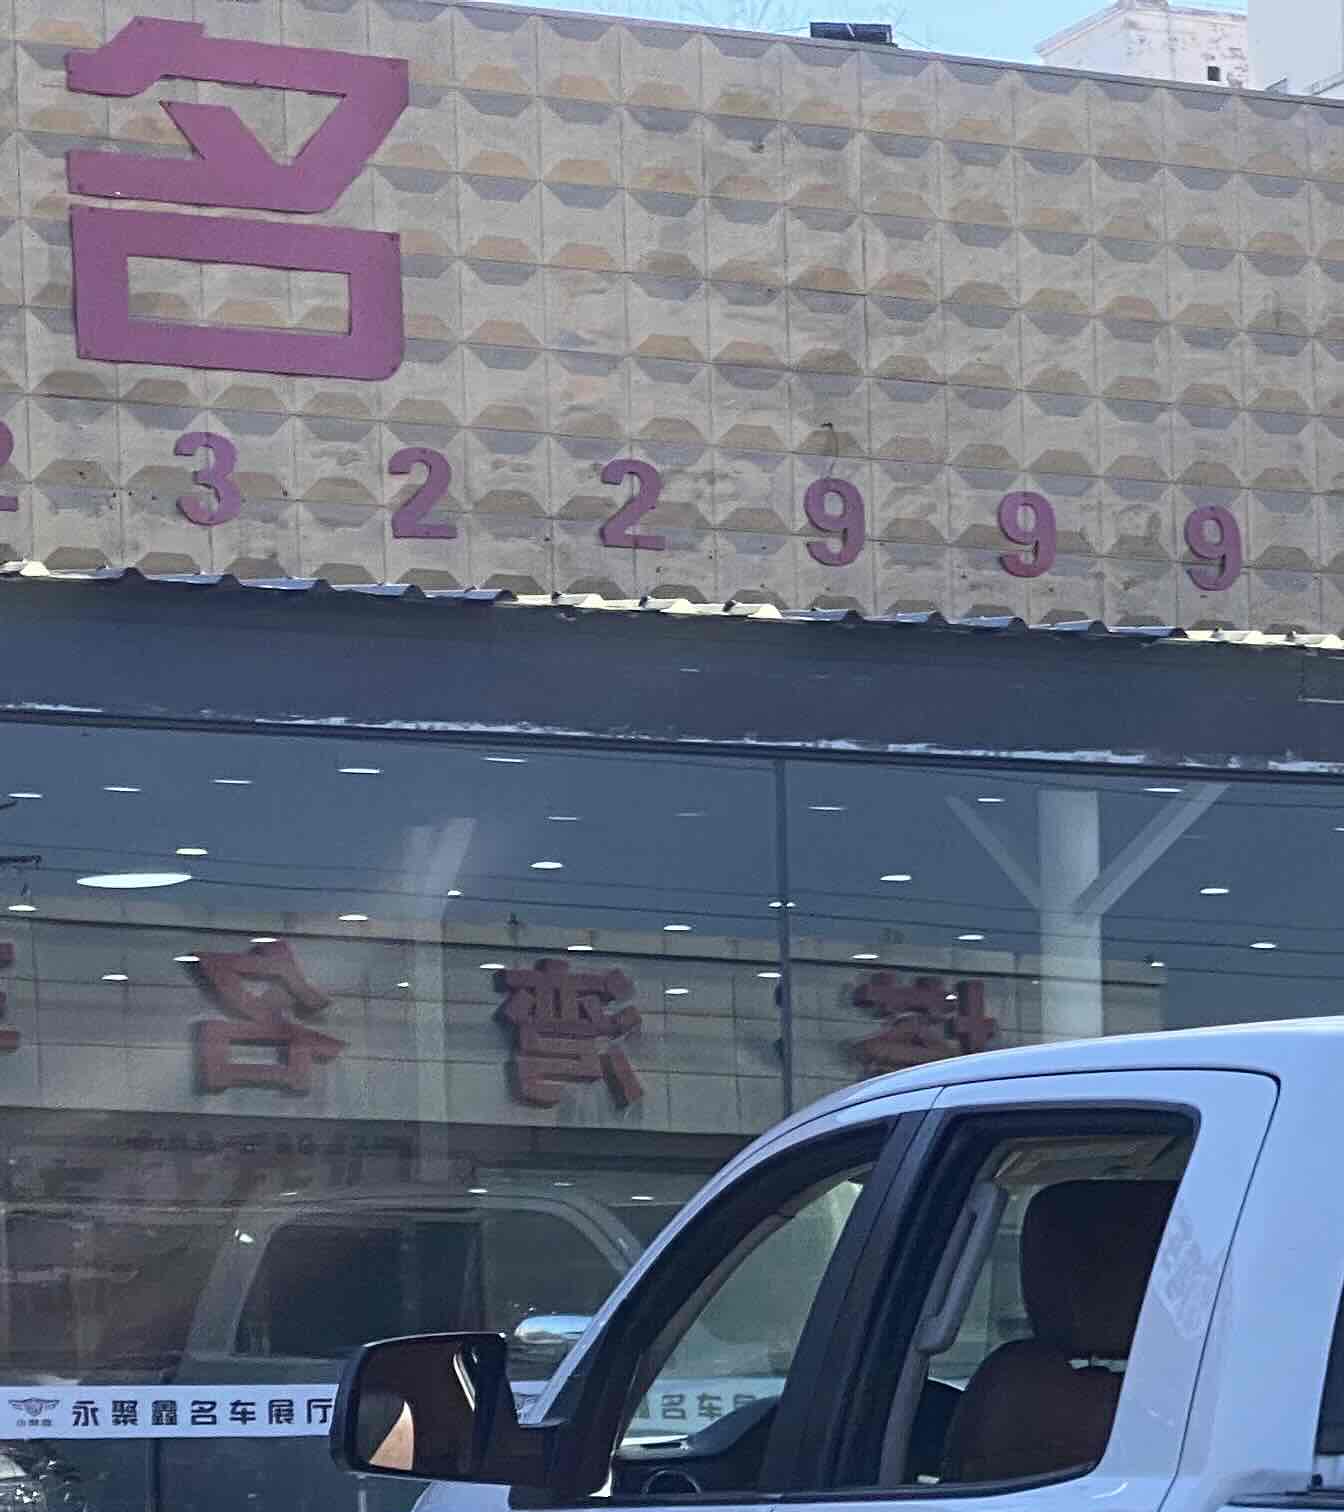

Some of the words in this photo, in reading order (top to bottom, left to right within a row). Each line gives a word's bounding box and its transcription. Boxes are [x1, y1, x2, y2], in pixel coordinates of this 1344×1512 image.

[71, 1397, 334, 1427] 永聚鑫名车展厅
